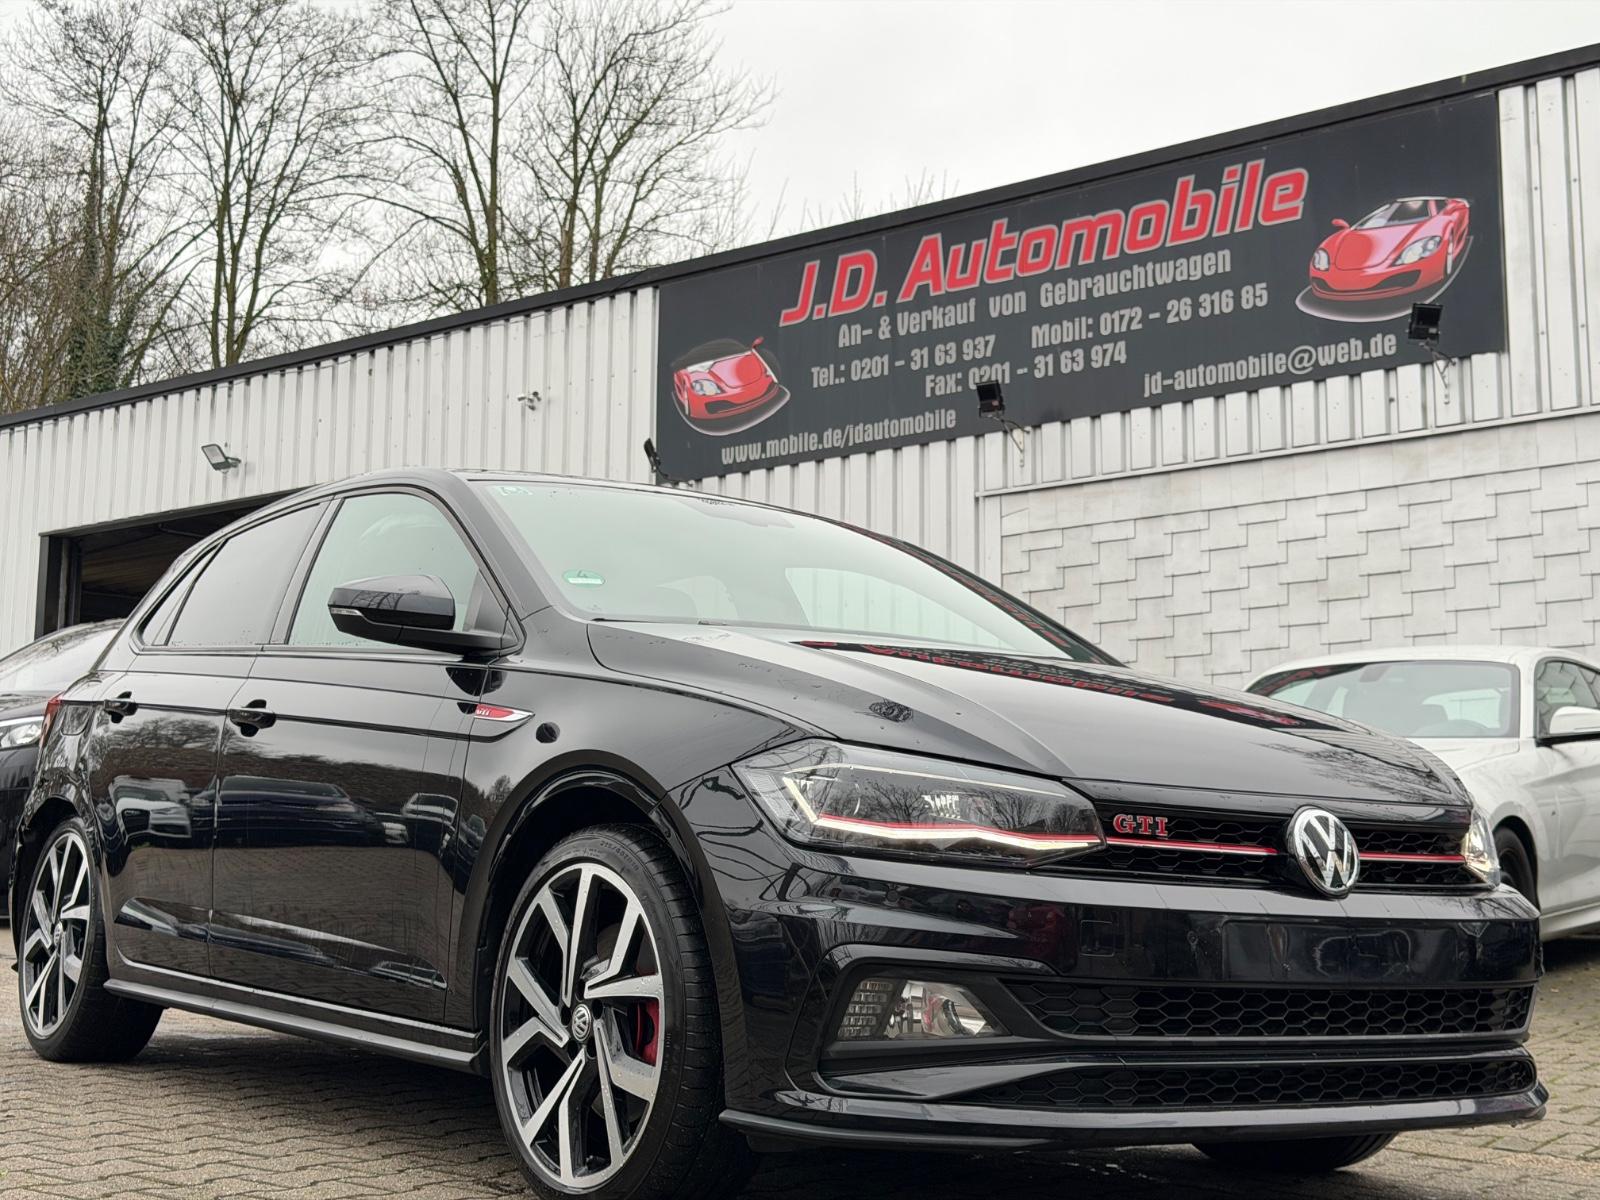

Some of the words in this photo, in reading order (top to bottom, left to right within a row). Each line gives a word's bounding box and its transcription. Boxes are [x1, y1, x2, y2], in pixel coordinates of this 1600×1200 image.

[779, 250, 888, 327] J.D.
[896, 158, 1309, 303] Automobile
[838, 324, 873, 348] An-
[878, 316, 891, 340] &
[897, 297, 976, 336] Verkauf
[988, 291, 1026, 318] von
[1040, 248, 1231, 308] Gebrauchtwagen
[1031, 315, 1093, 349] Mobil:
[1100, 306, 1143, 336] 0172
[1166, 297, 1192, 324] 26
[1199, 289, 1233, 318] 316
[1241, 283, 1268, 309] 85
[811, 363, 845, 389] Tel.:
[851, 354, 889, 381] 0201
[910, 346, 929, 371] 31
[934, 342, 957, 366] 63
[962, 334, 996, 361] 937
[925, 372, 962, 398] Fax:
[1034, 353, 1054, 379] 31
[1060, 349, 1084, 374] 63
[1090, 340, 1128, 369] 974
[1143, 333, 1397, 398] jd-automobile@web.de
[721, 408, 957, 465] www.mobile.de/jdautomobile
[1113, 813, 1168, 836] GTI
